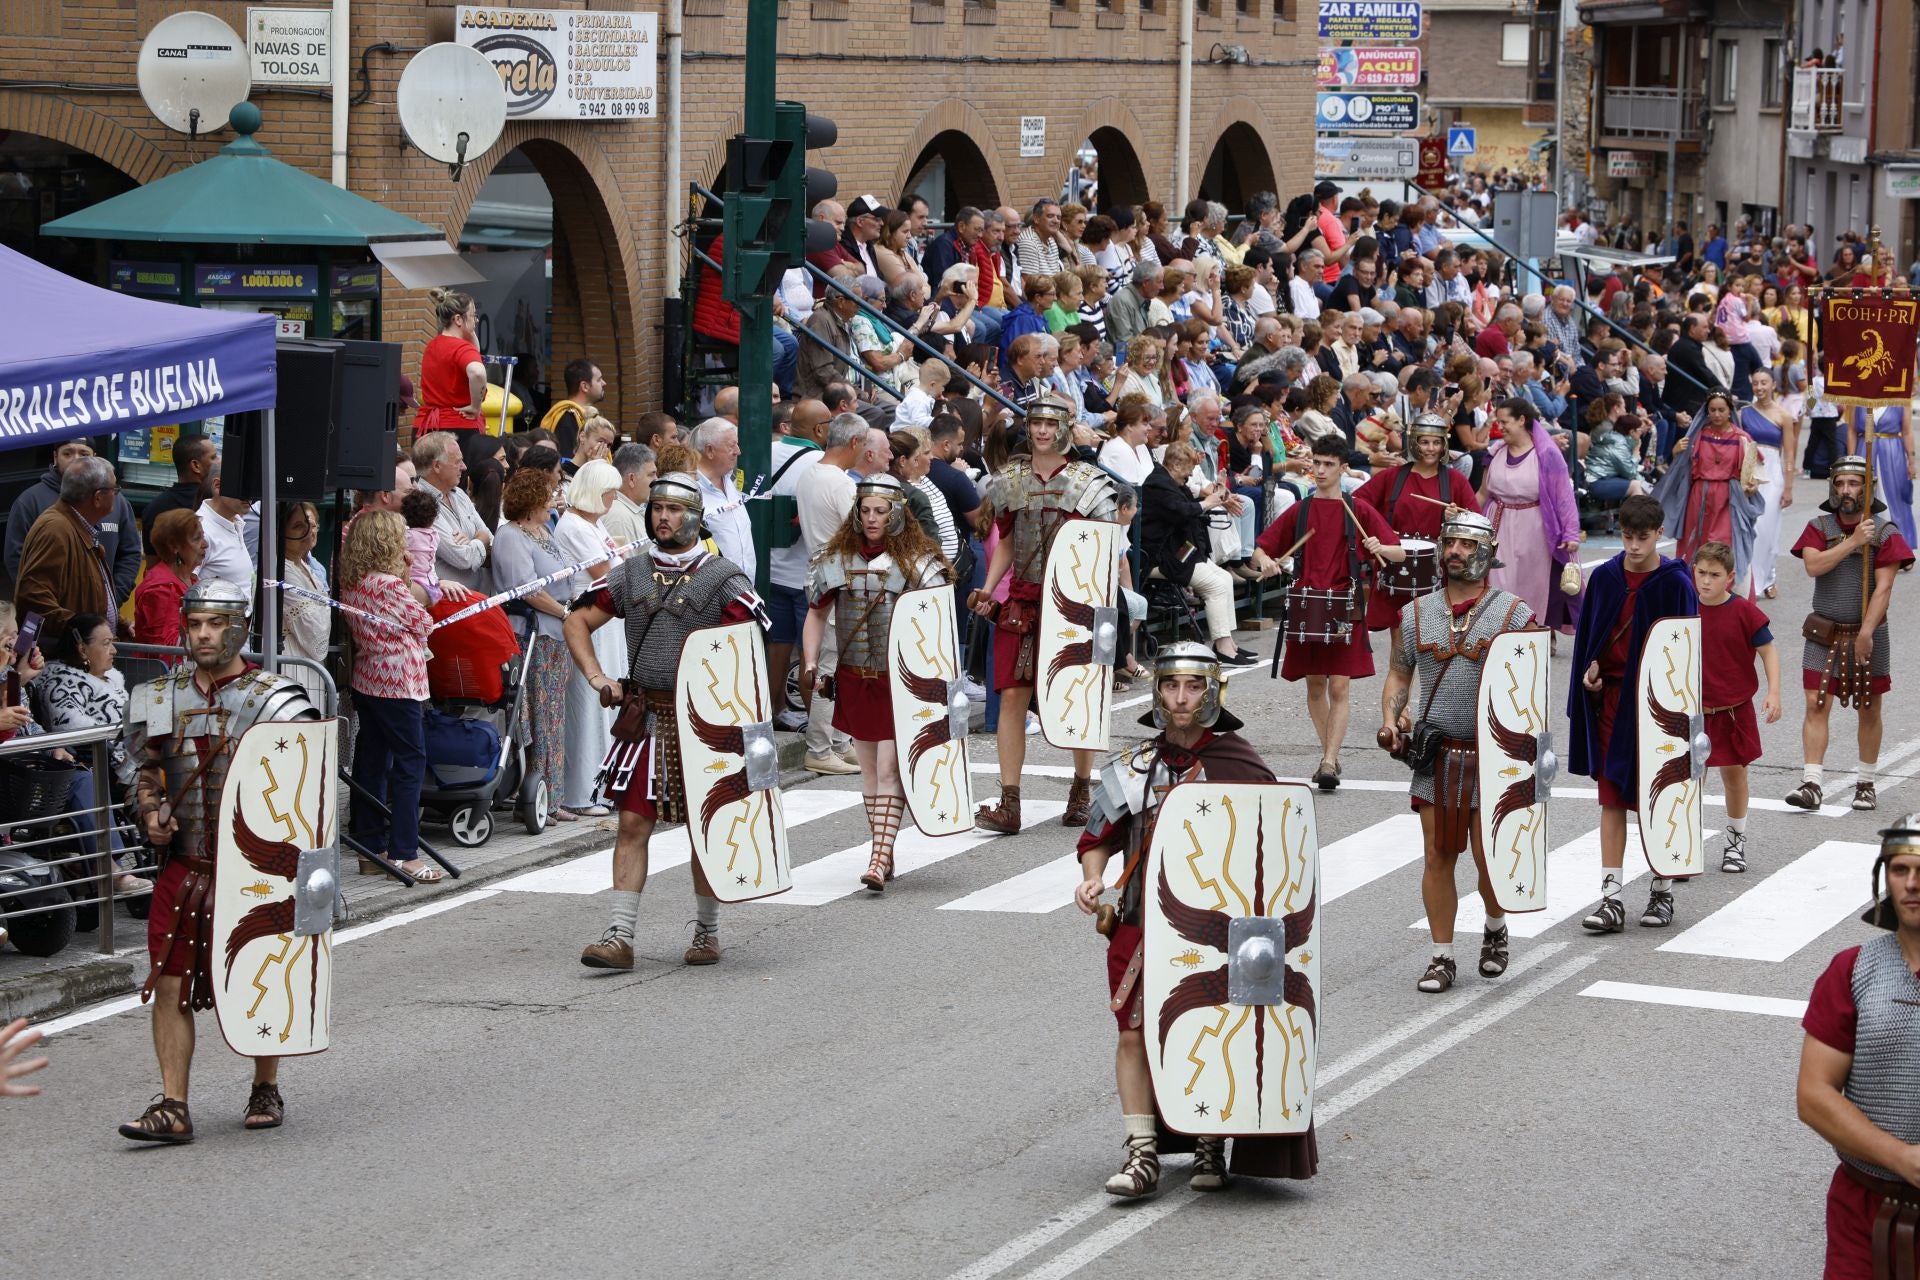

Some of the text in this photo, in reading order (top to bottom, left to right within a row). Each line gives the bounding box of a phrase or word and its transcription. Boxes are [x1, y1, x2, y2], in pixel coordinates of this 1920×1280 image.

[1355, 3, 1418, 16] FAMILIA
[460, 10, 558, 31] ACADEMIA
[574, 15, 632, 28] PRIMARIA
[270, 26, 325, 36] PROLONGACION
[574, 29, 649, 43] SECUNDARIA
[159, 49, 186, 57] CANAL
[254, 43, 326, 56] NAVAS DE
[574, 44, 639, 57] BACHILLER
[1358, 50, 1416, 60] ANÚNCIATE
[261, 61, 320, 75] TOLOSA
[574, 58, 631, 71] MODULOS
[1360, 59, 1413, 73] AQUÍ
[494, 52, 556, 94] rela
[574, 73, 593, 86] F.P.
[1367, 73, 1382, 83] 619
[1383, 73, 1399, 83] 472
[574, 87, 653, 101] UNIVERSIDAD
[588, 102, 650, 116] 942 08 99 98
[241, 275, 303, 288] 1.000.000 €
[92, 372, 130, 422] DE
[130, 357, 225, 417] BUELNA
